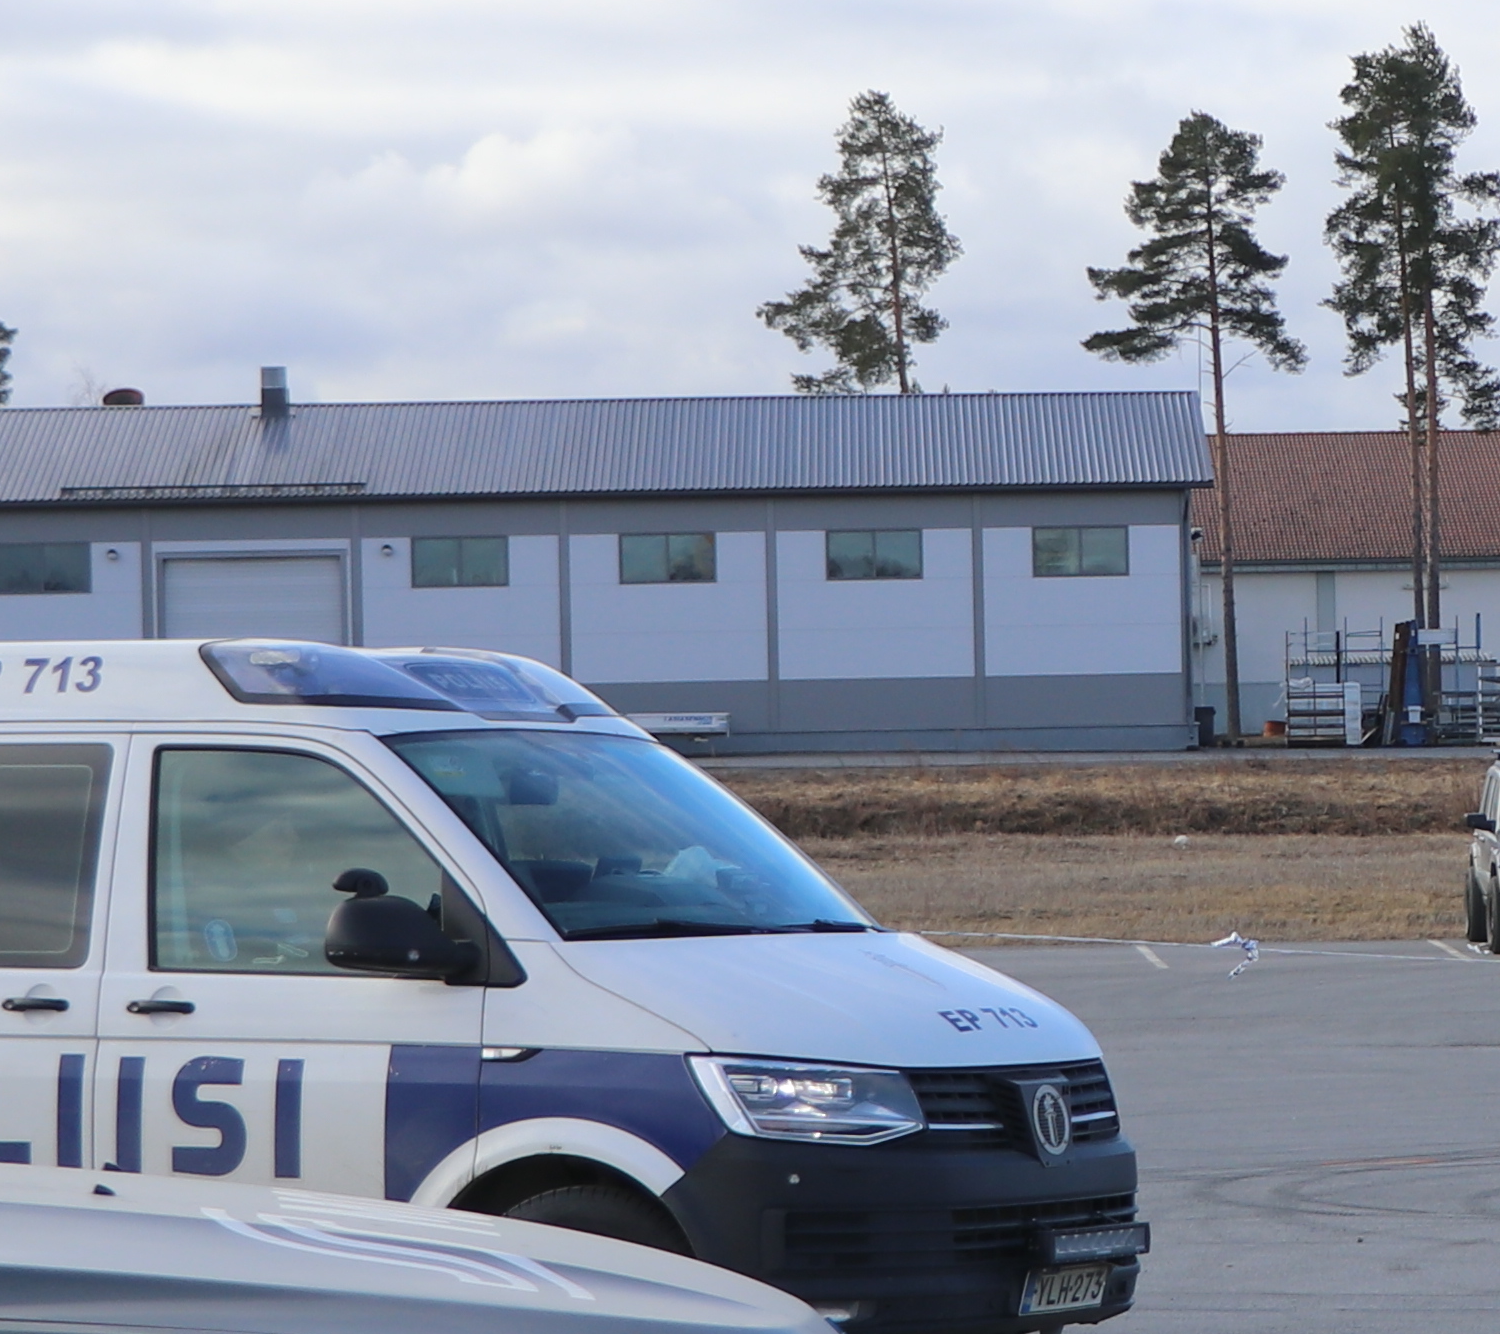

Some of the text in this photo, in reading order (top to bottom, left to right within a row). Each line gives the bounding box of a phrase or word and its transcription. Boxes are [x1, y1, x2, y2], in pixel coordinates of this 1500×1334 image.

[23, 655, 104, 694] 713
[937, 1006, 1039, 1033] EP 713
[1038, 1271, 1104, 1306] YLH-273
